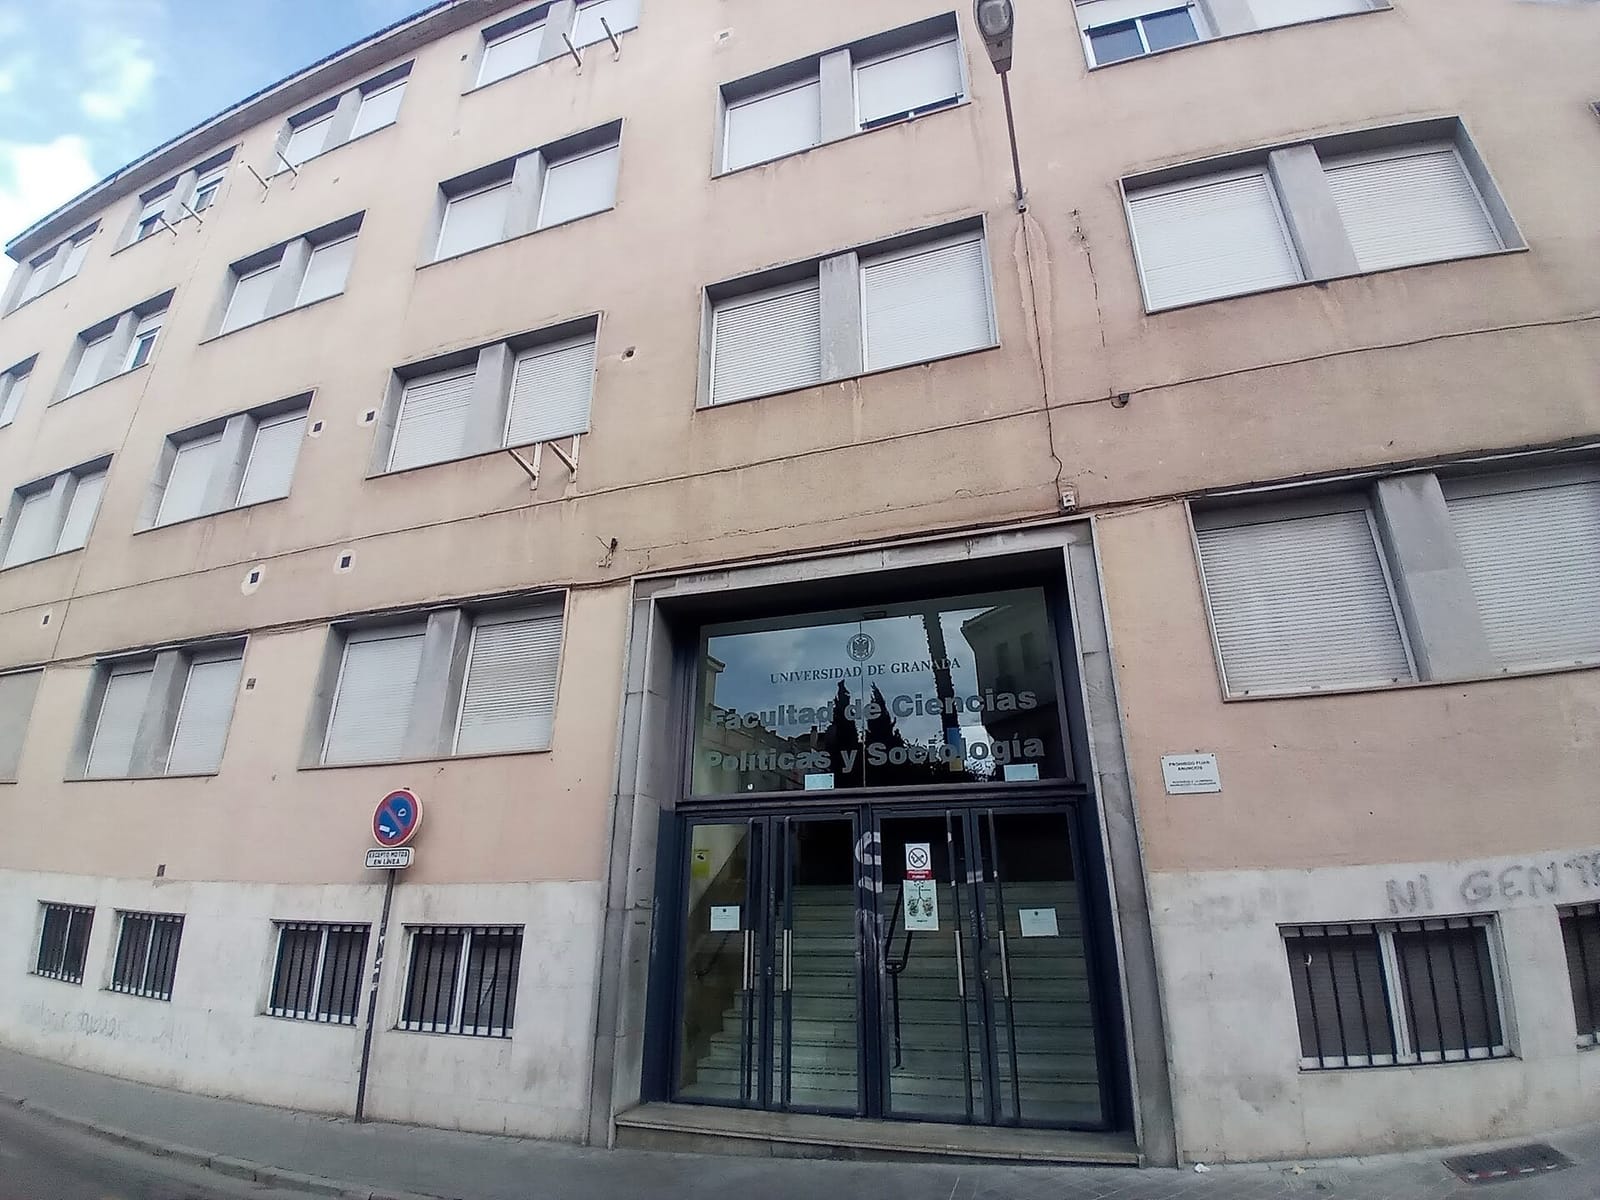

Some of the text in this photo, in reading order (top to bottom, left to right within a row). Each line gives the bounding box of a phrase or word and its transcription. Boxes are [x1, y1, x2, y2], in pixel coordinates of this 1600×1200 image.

[770, 658, 961, 684] UNIVERSIDAD DE GRANADA
[710, 688, 1038, 730] Facultad de Ciencias
[842, 748, 860, 773] y
[867, 732, 1045, 766] Sociología
[1386, 874, 1435, 914] NI
